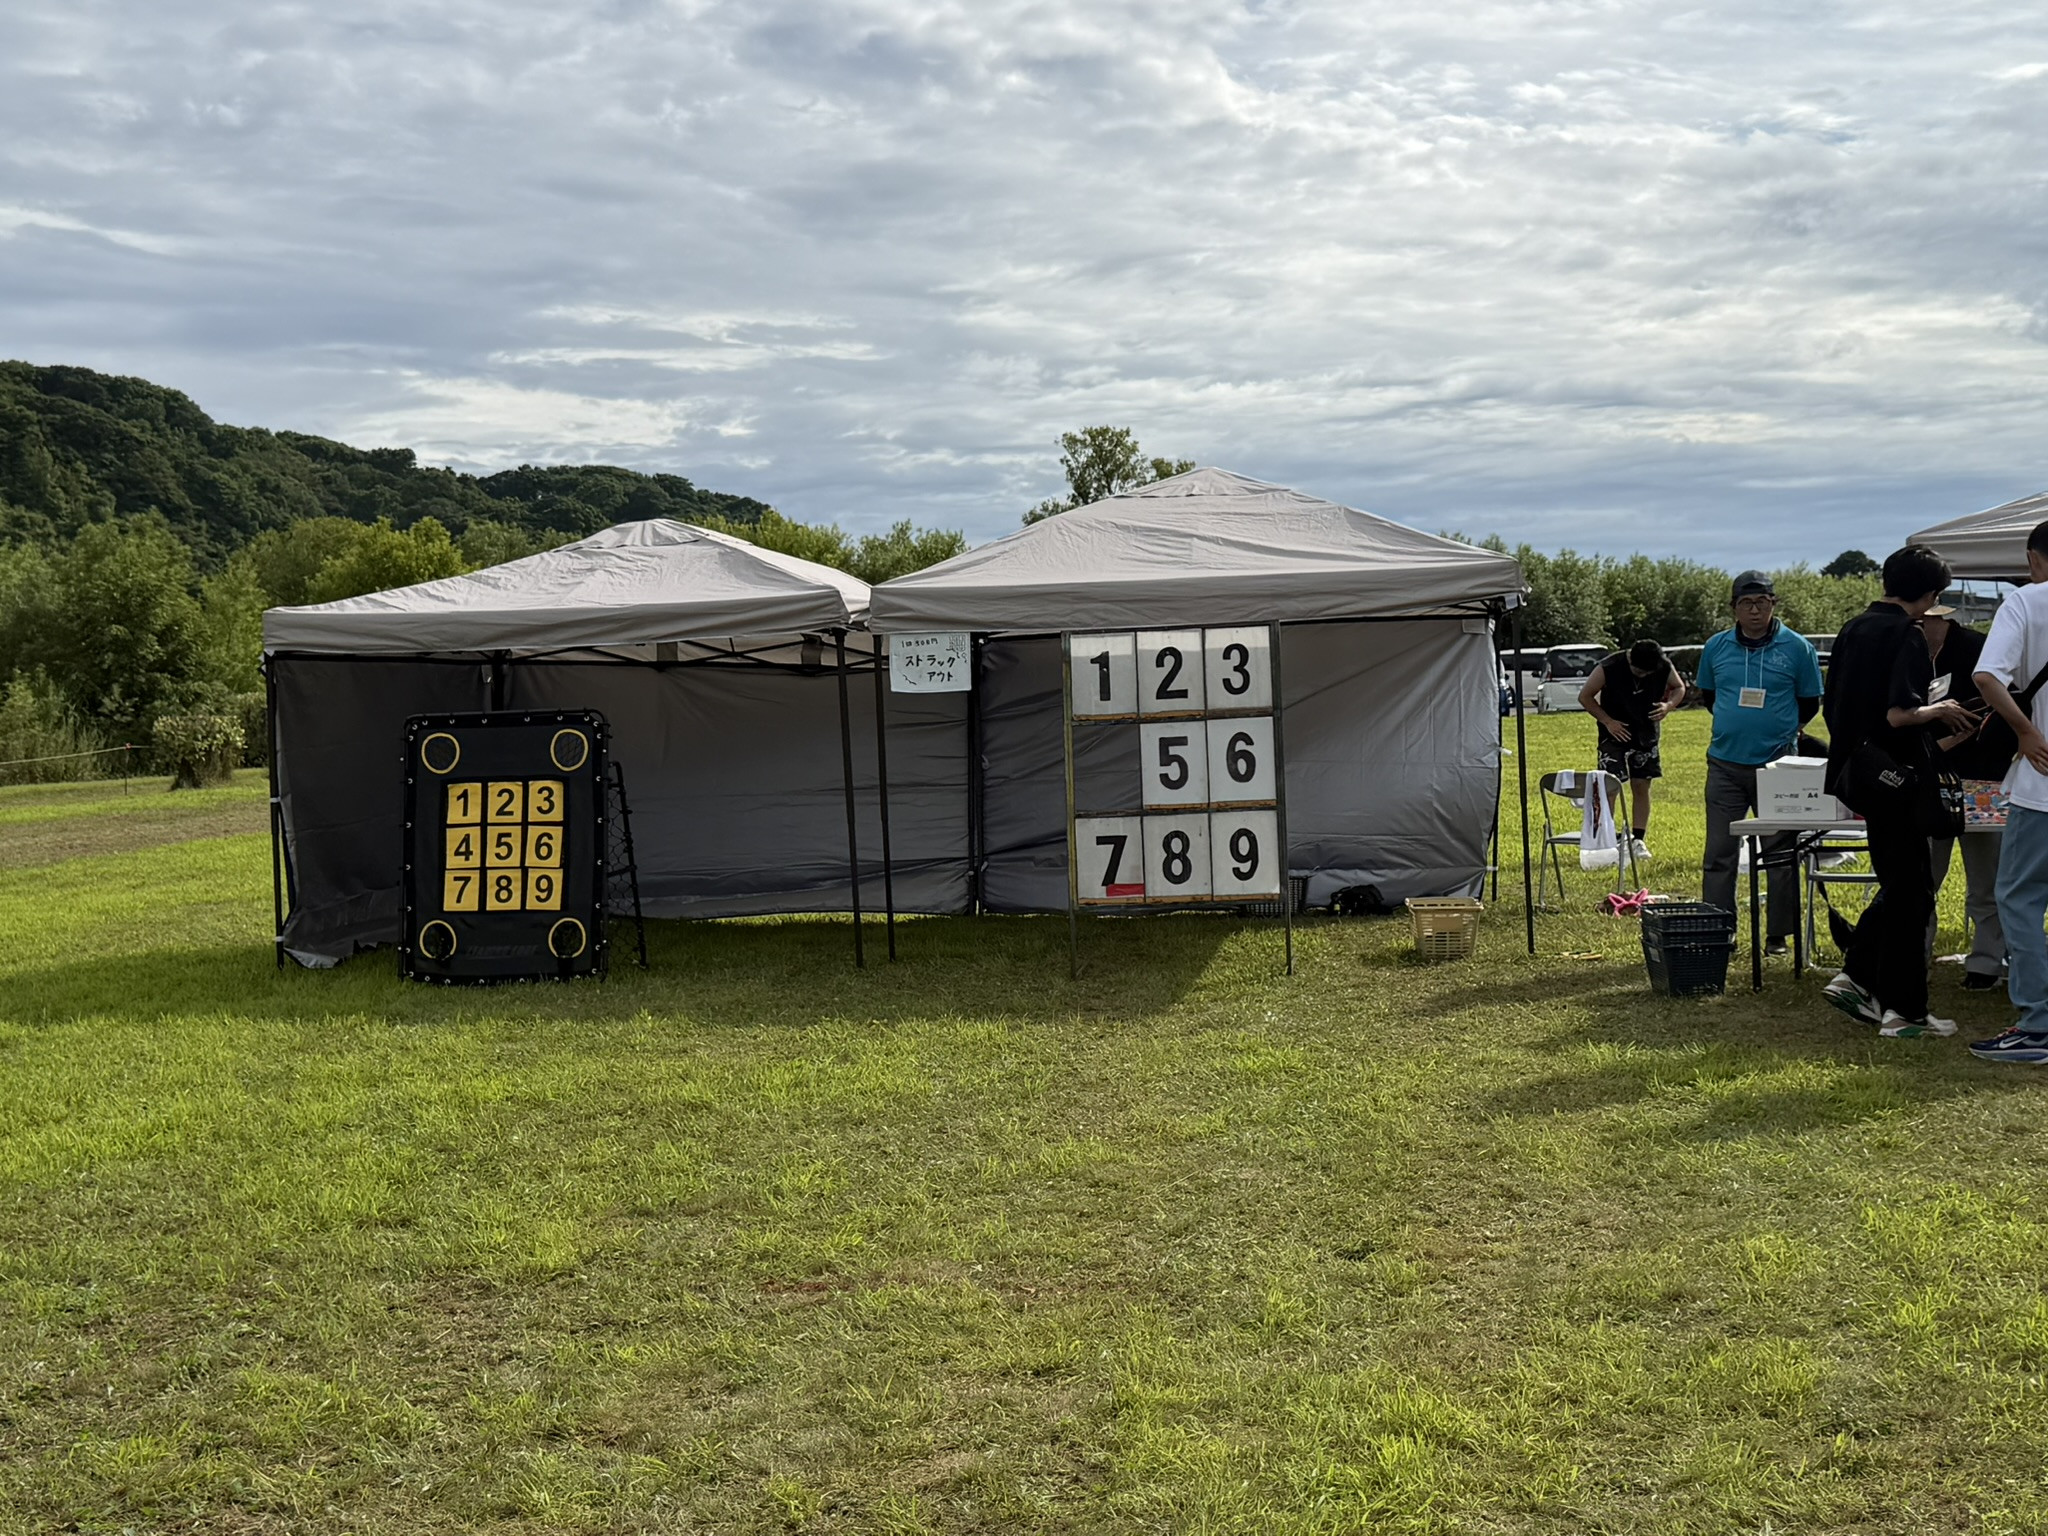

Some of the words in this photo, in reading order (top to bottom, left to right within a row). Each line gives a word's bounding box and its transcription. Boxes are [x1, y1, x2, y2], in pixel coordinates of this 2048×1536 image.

[905, 655, 955, 667] ストラック
[1090, 651, 1111, 701] 1
[1155, 646, 1189, 700] 2
[1222, 643, 1251, 695] 3
[927, 671, 953, 682] アウト
[1159, 736, 1189, 790] 5
[1226, 732, 1256, 783] 6
[456, 788, 470, 817] 1
[496, 788, 515, 817] 2
[536, 786, 555, 815] 3
[454, 833, 473, 862] 4
[495, 832, 513, 861] 5
[534, 832, 554, 861] 6
[1096, 835, 1128, 887] 7
[1162, 830, 1192, 885] 8
[1229, 828, 1259, 881] 9
[453, 876, 472, 904] 7
[495, 875, 513, 904] 8
[535, 874, 554, 903] 9
